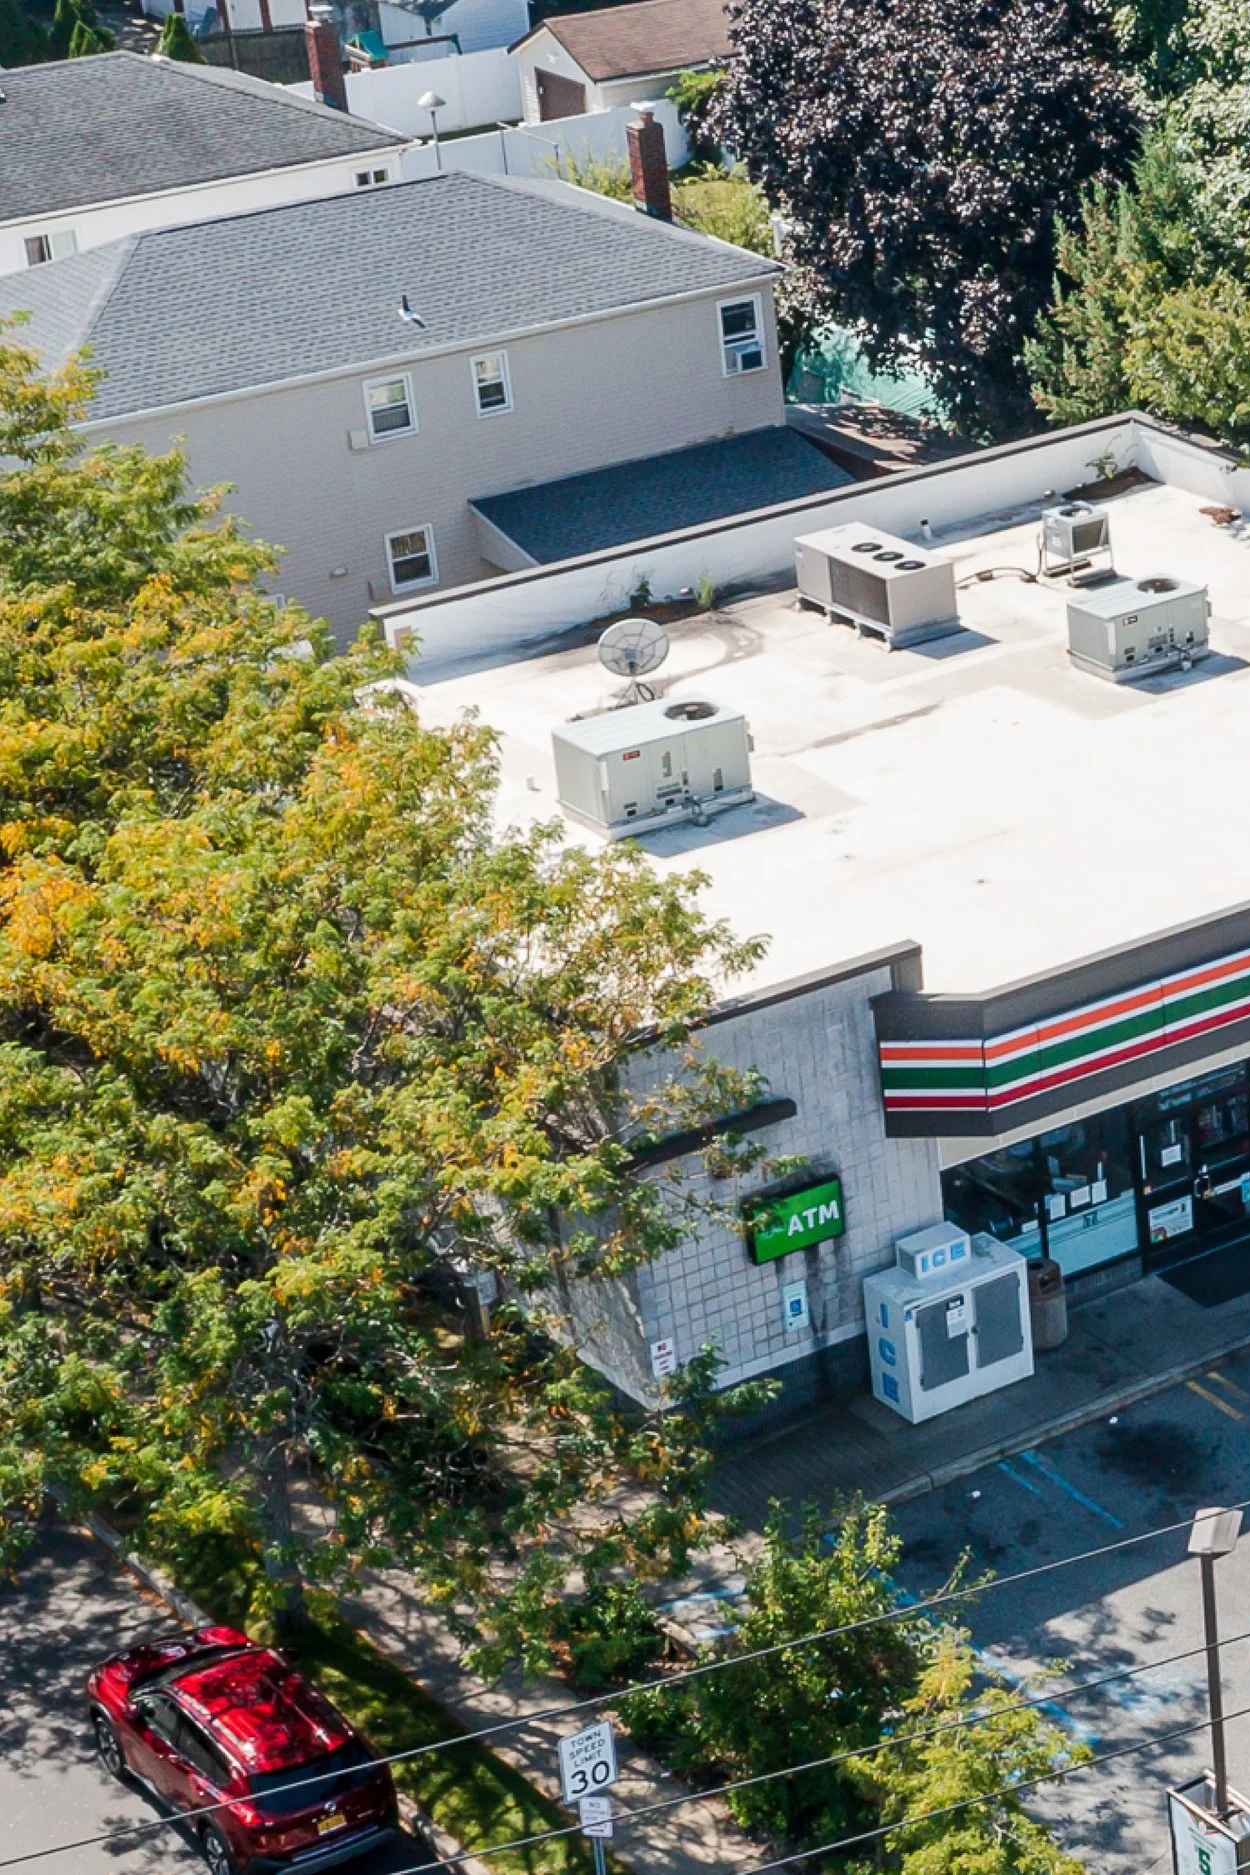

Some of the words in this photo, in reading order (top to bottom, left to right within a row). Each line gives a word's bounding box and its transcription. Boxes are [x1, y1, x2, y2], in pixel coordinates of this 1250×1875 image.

[787, 1199, 839, 1237] ATM
[921, 1240, 966, 1273] ICE
[879, 1303, 900, 1403] ICE
[569, 1739, 605, 1759] SPEED
[571, 1730, 601, 1748] TOWN
[574, 1750, 602, 1768] LIMIT
[570, 1760, 610, 1794] 30
